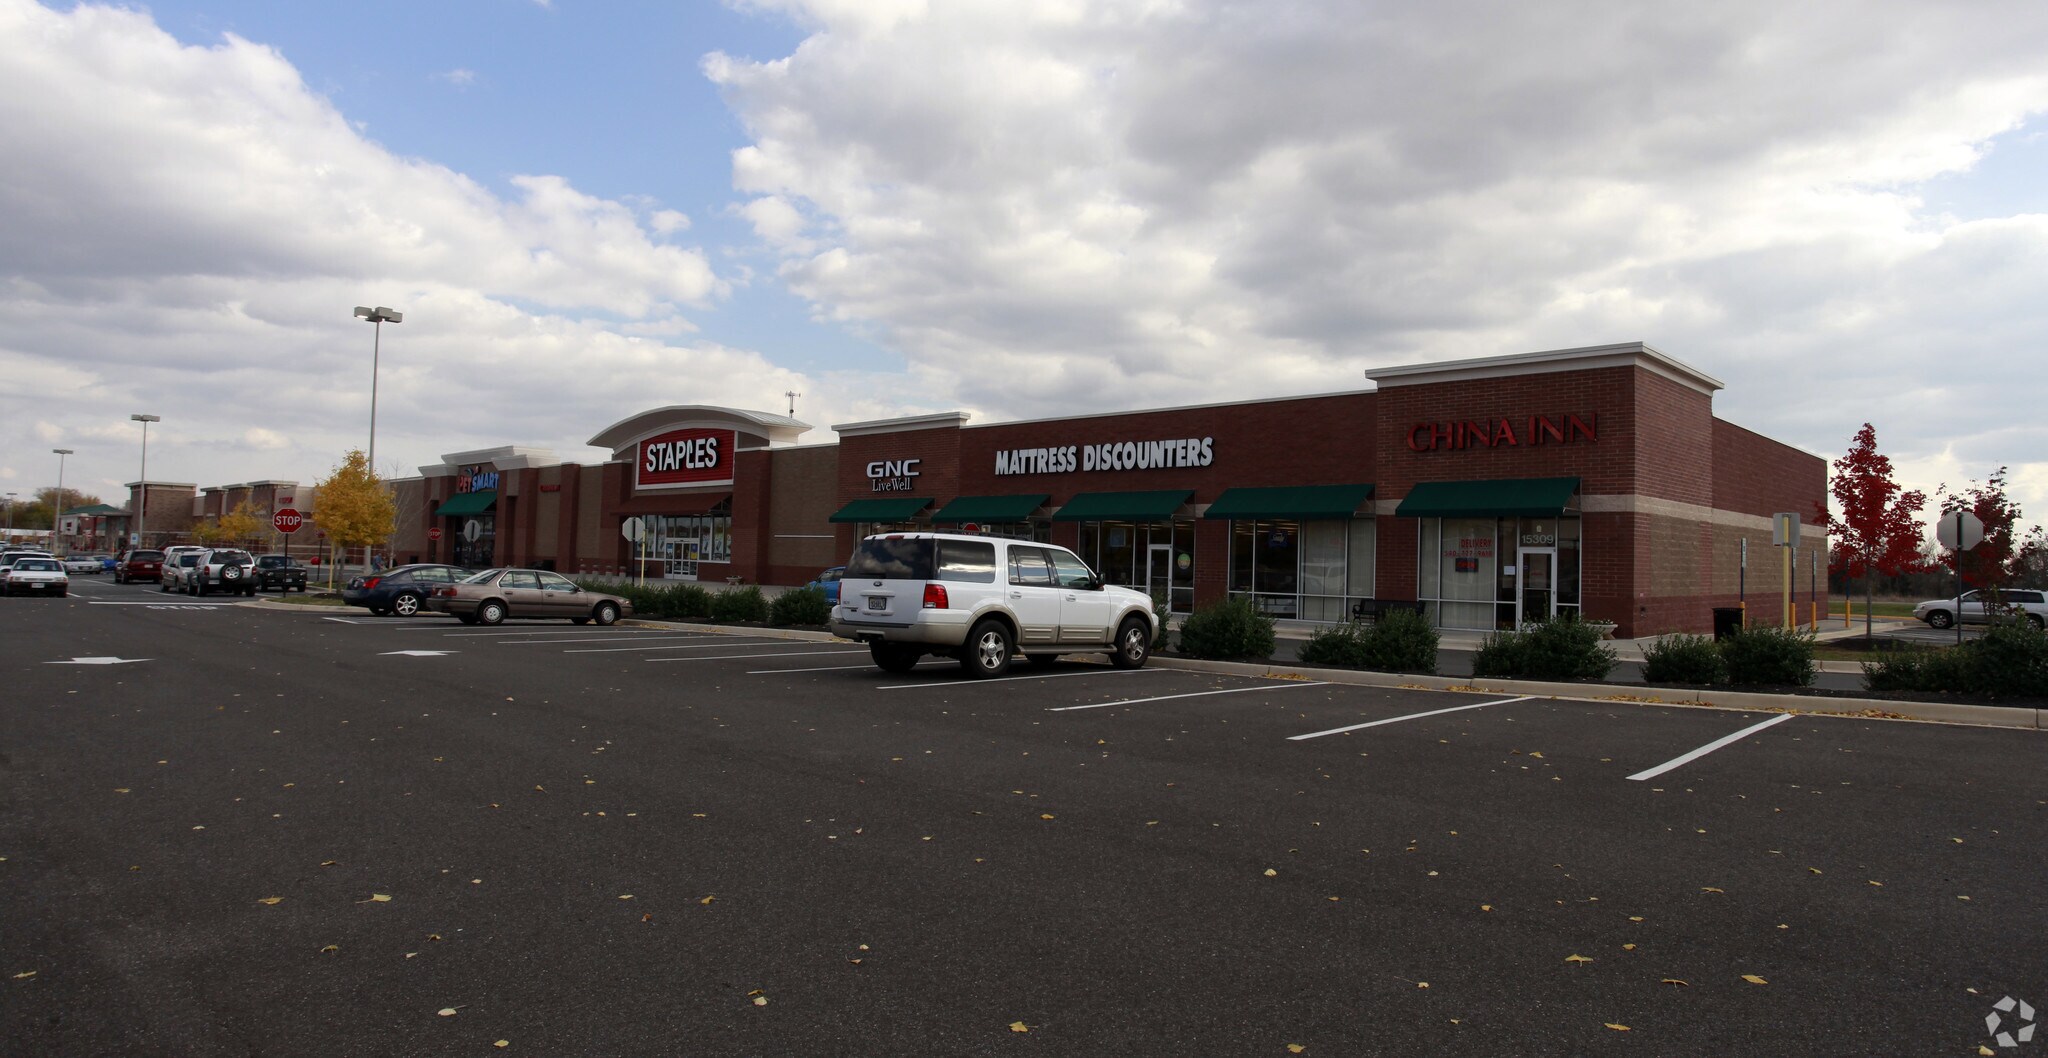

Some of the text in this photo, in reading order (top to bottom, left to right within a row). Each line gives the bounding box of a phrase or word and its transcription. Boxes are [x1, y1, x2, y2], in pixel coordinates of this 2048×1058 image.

[1407, 412, 1598, 451] CHINA INN
[646, 437, 717, 472] STAPLES
[995, 437, 1213, 475] MATTRESS DISCOUNTERS
[866, 459, 920, 478] GNC
[275, 515, 300, 525] STOP
[1461, 538, 1492, 548] DELIVERY
[1521, 534, 1554, 544] 15309
